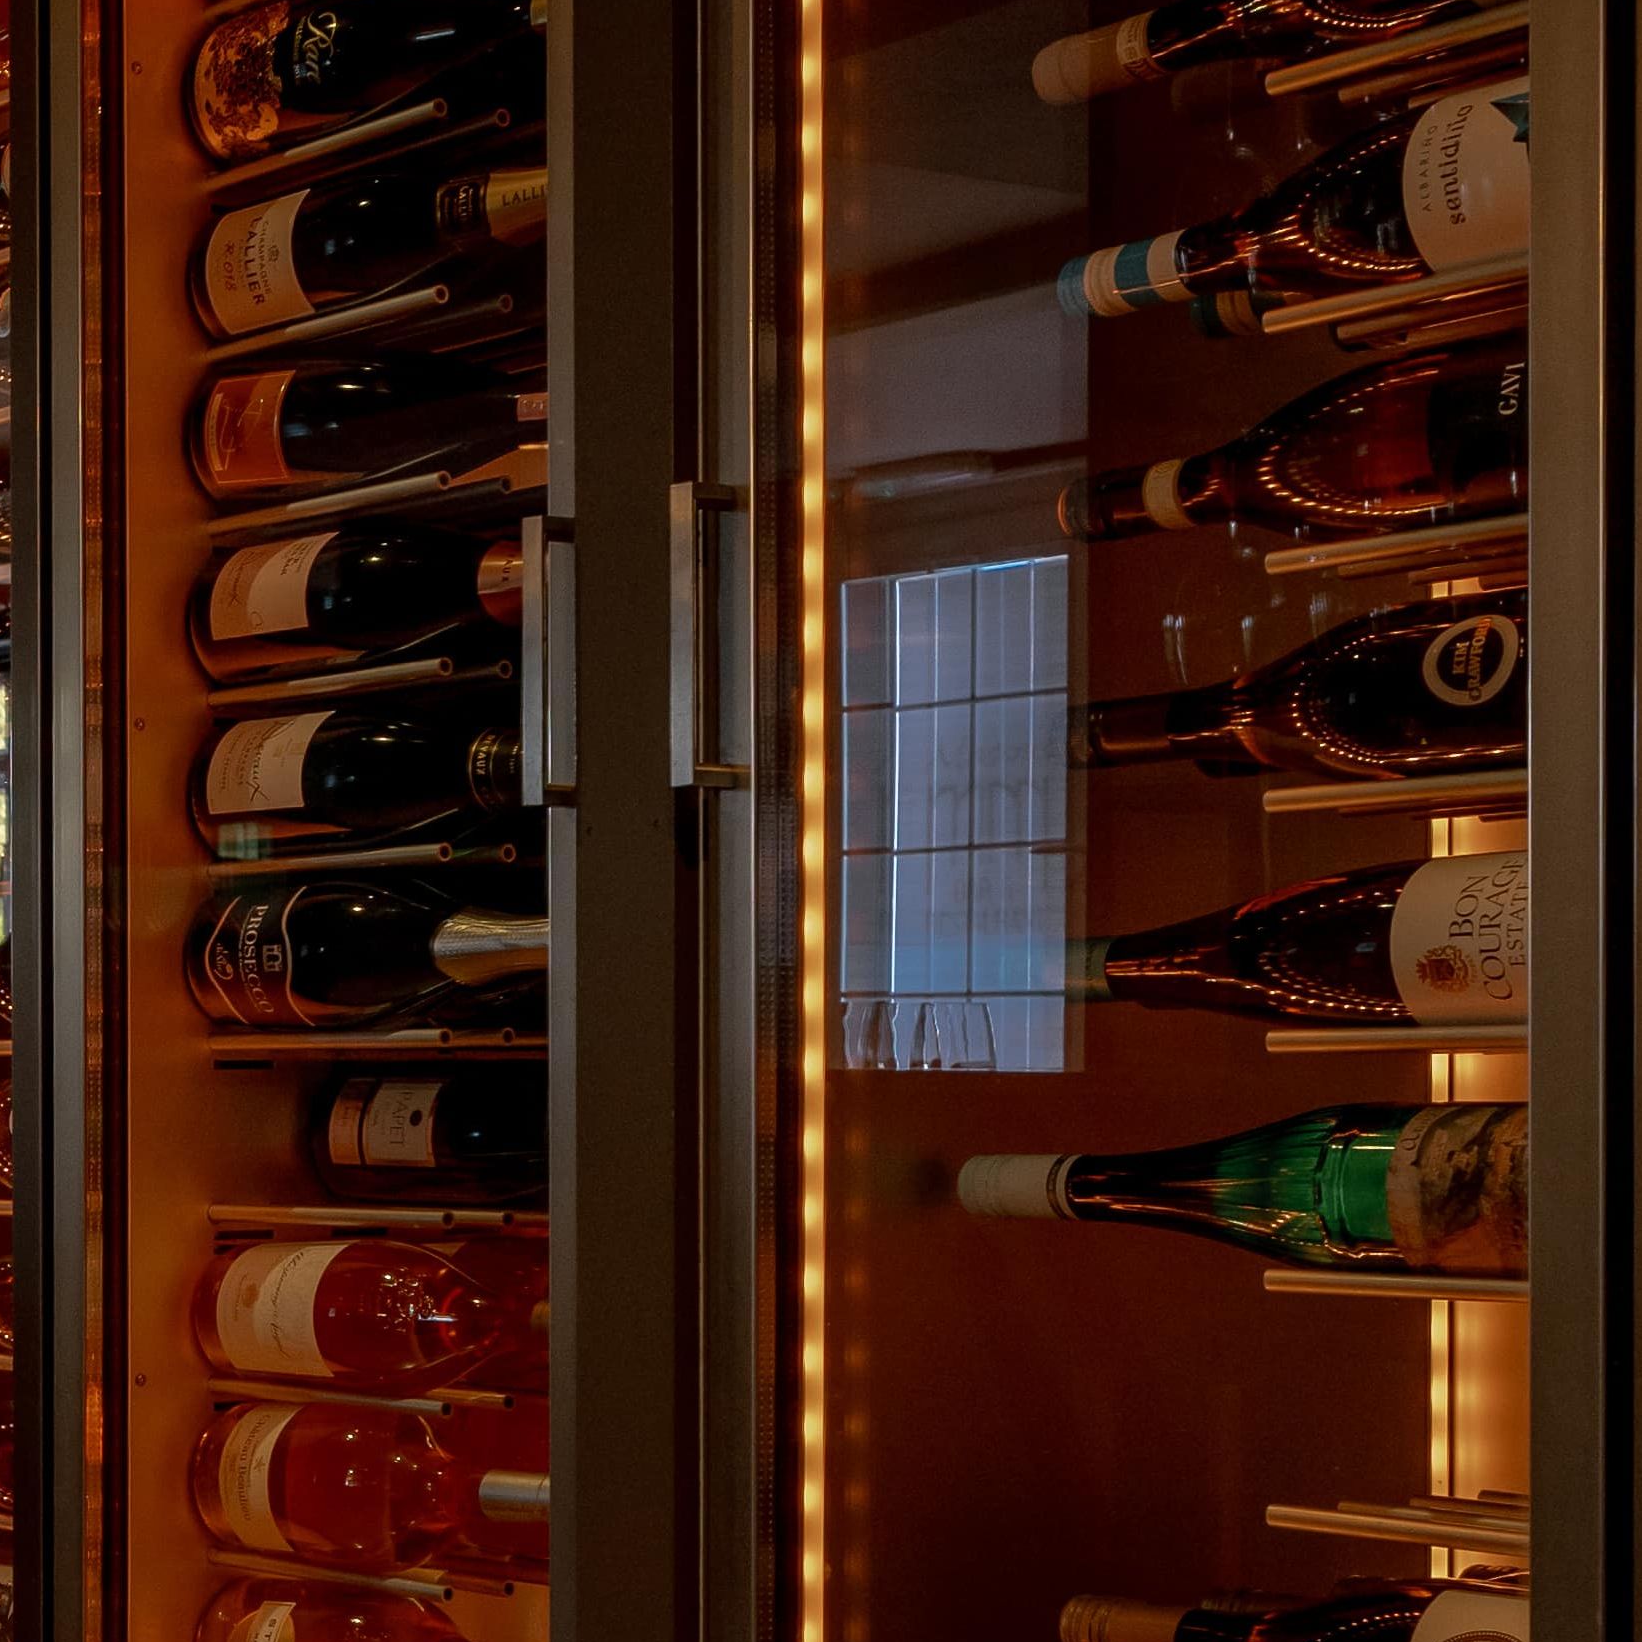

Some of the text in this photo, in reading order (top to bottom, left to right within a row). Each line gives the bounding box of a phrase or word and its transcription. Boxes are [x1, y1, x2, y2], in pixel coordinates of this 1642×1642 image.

[303, 11, 336, 85] Rare
[1438, 104, 1475, 224] sentidiño
[243, 215, 265, 306] LALLIER
[1498, 361, 1526, 415] GAVI
[1452, 641, 1469, 674] KIM
[1466, 617, 1493, 700] CRAWFORD
[1447, 874, 1489, 939] BON
[1478, 857, 1523, 1000] COURAGE
[244, 903, 275, 1013] PROSECCO
[389, 1091, 412, 1147] PAPET
